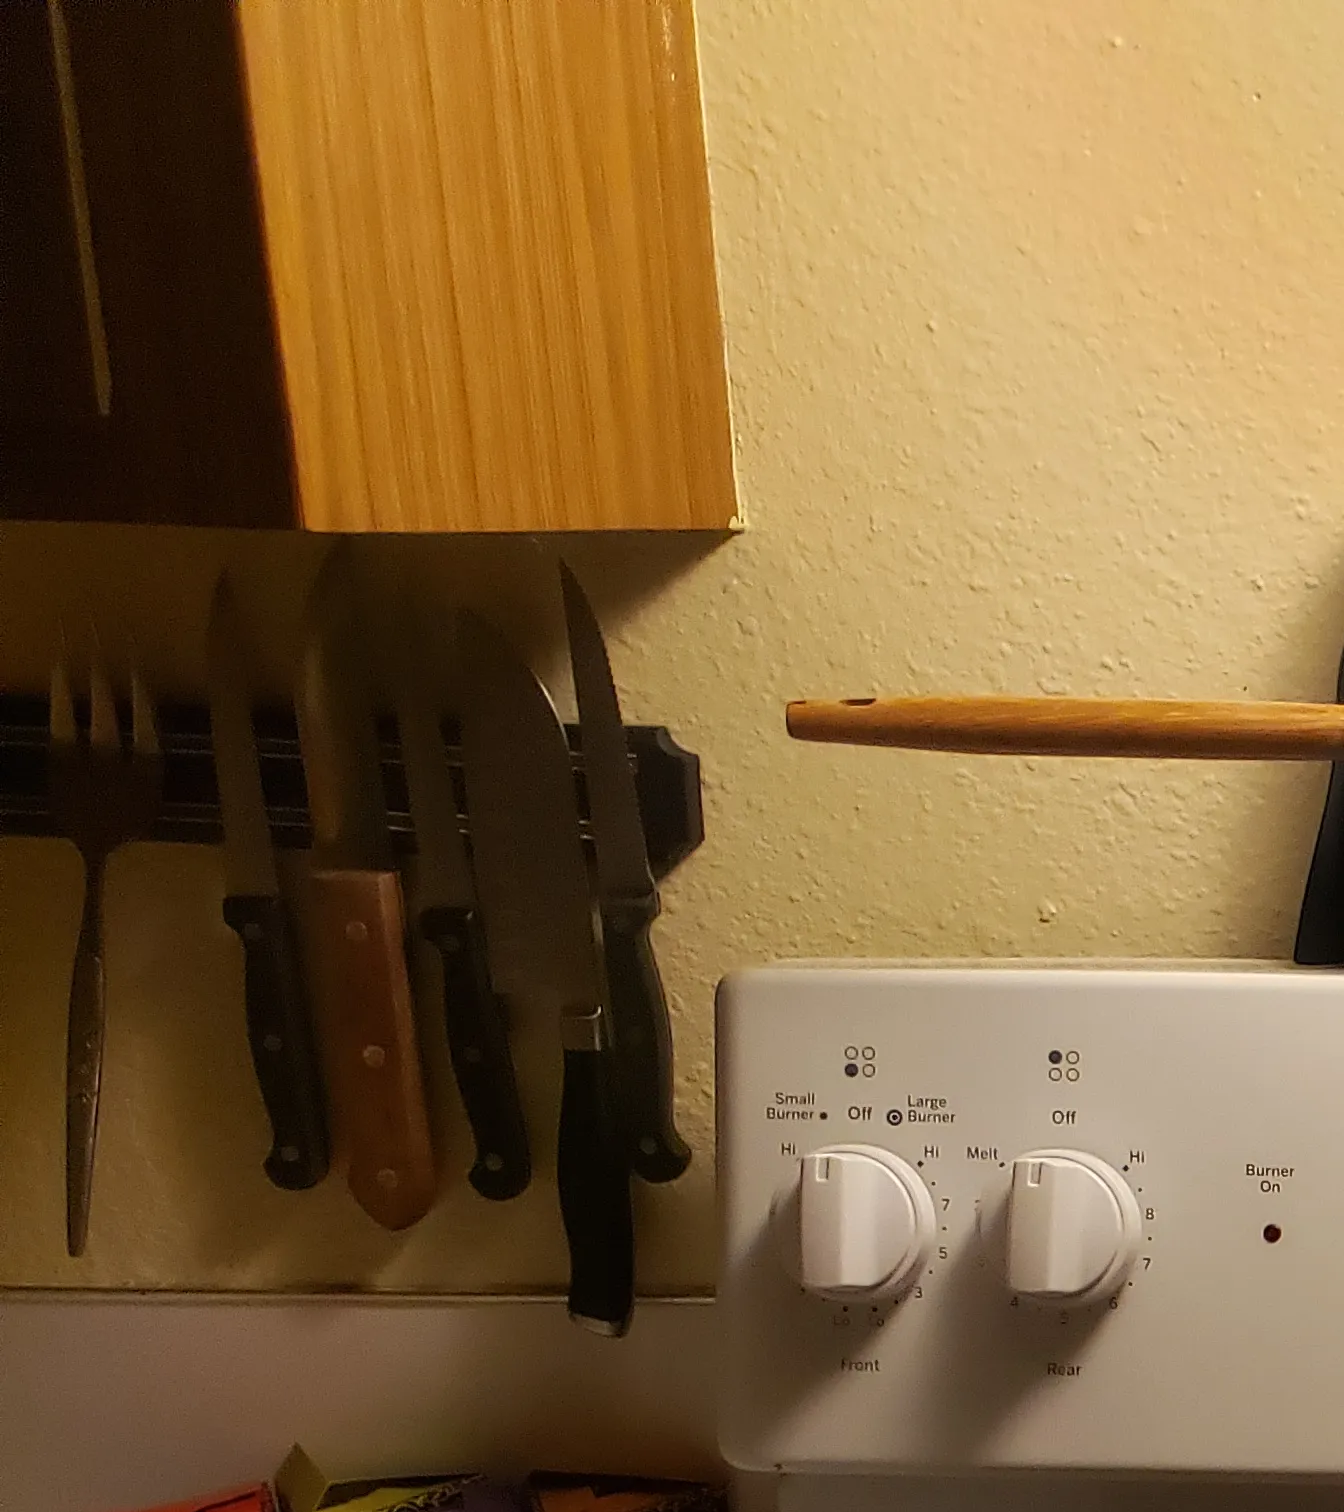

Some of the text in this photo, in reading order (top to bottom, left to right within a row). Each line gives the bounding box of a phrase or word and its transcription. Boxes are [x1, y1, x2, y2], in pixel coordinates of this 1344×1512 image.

[775, 1092, 815, 1106] Small
[907, 1094, 947, 1109] Large
[766, 1107, 814, 1120] Burner
[847, 1106, 873, 1121] Off
[907, 1110, 955, 1123] Burner
[1051, 1109, 1077, 1125] Off
[781, 1142, 796, 1155] Hi
[924, 1145, 939, 1158] Hi
[966, 1146, 999, 1161] Melt
[1129, 1150, 1145, 1164] Hi
[1245, 1163, 1295, 1177] Burner
[1260, 1180, 1281, 1193] On
[941, 1199, 950, 1211] 7
[1145, 1208, 1155, 1220] 8
[938, 1246, 947, 1260] 5
[1143, 1258, 1151, 1271] 7
[914, 1286, 923, 1299] 3
[1109, 1296, 1118, 1310] 6
[840, 1358, 880, 1372] Front
[1046, 1362, 1082, 1376] Rear
